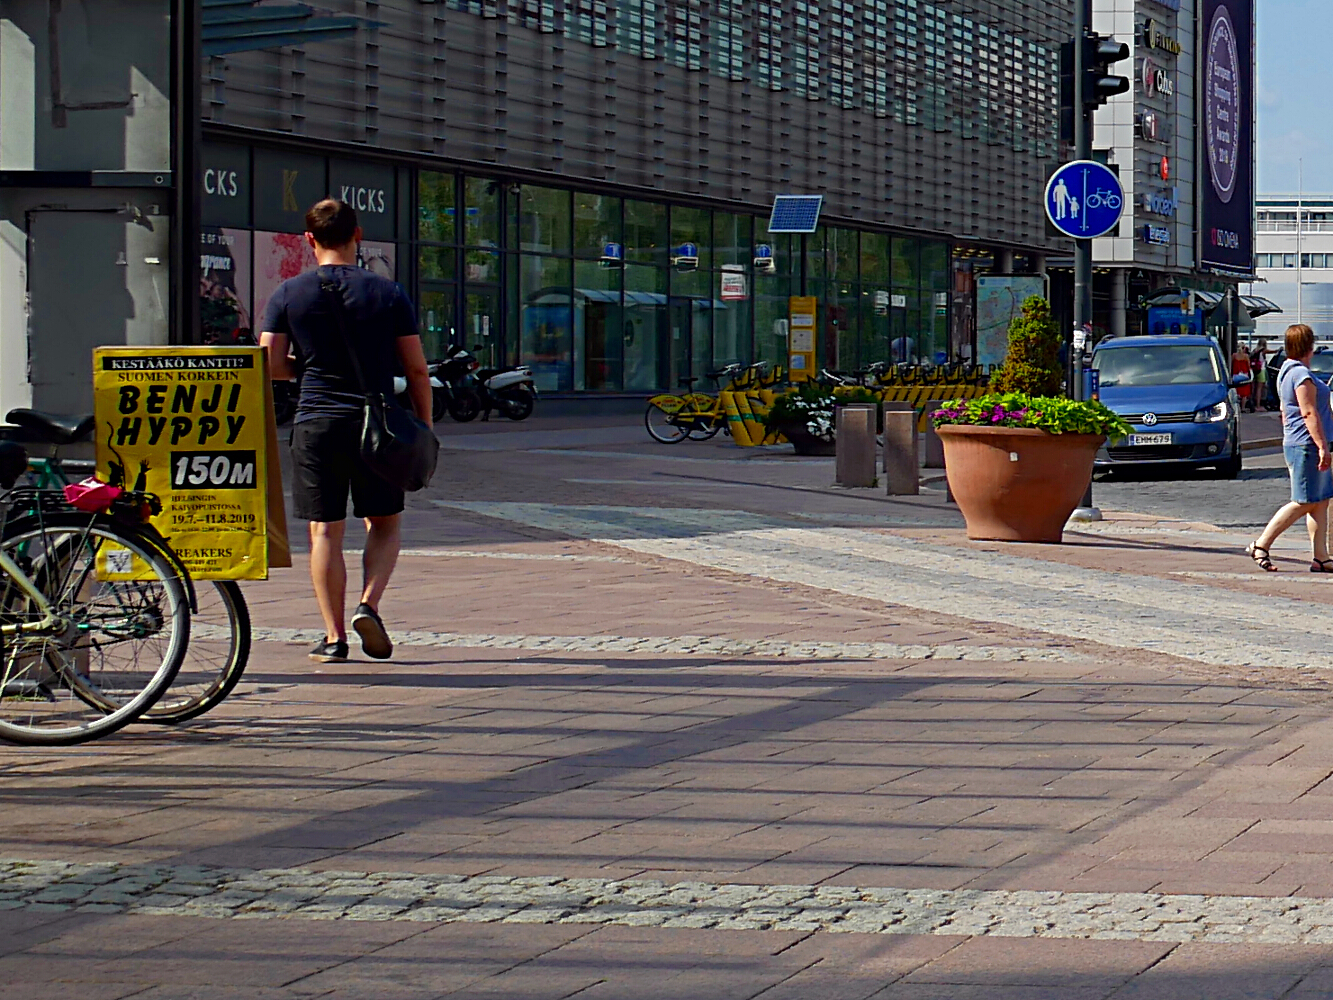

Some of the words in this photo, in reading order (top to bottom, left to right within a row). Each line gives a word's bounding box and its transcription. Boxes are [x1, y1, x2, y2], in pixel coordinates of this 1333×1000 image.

[204, 168, 238, 197] CKS
[341, 185, 385, 214] KICKS
[111, 357, 185, 369] KESTÄÄKÖ
[187, 357, 244, 369] KANTTI?
[118, 372, 174, 382] SUOMEN
[177, 371, 239, 381] KORKEIN
[118, 384, 242, 415] BENJI
[116, 415, 246, 446] HYPPY
[174, 455, 254, 486] 150M
[175, 548, 233, 558] REAKERS
